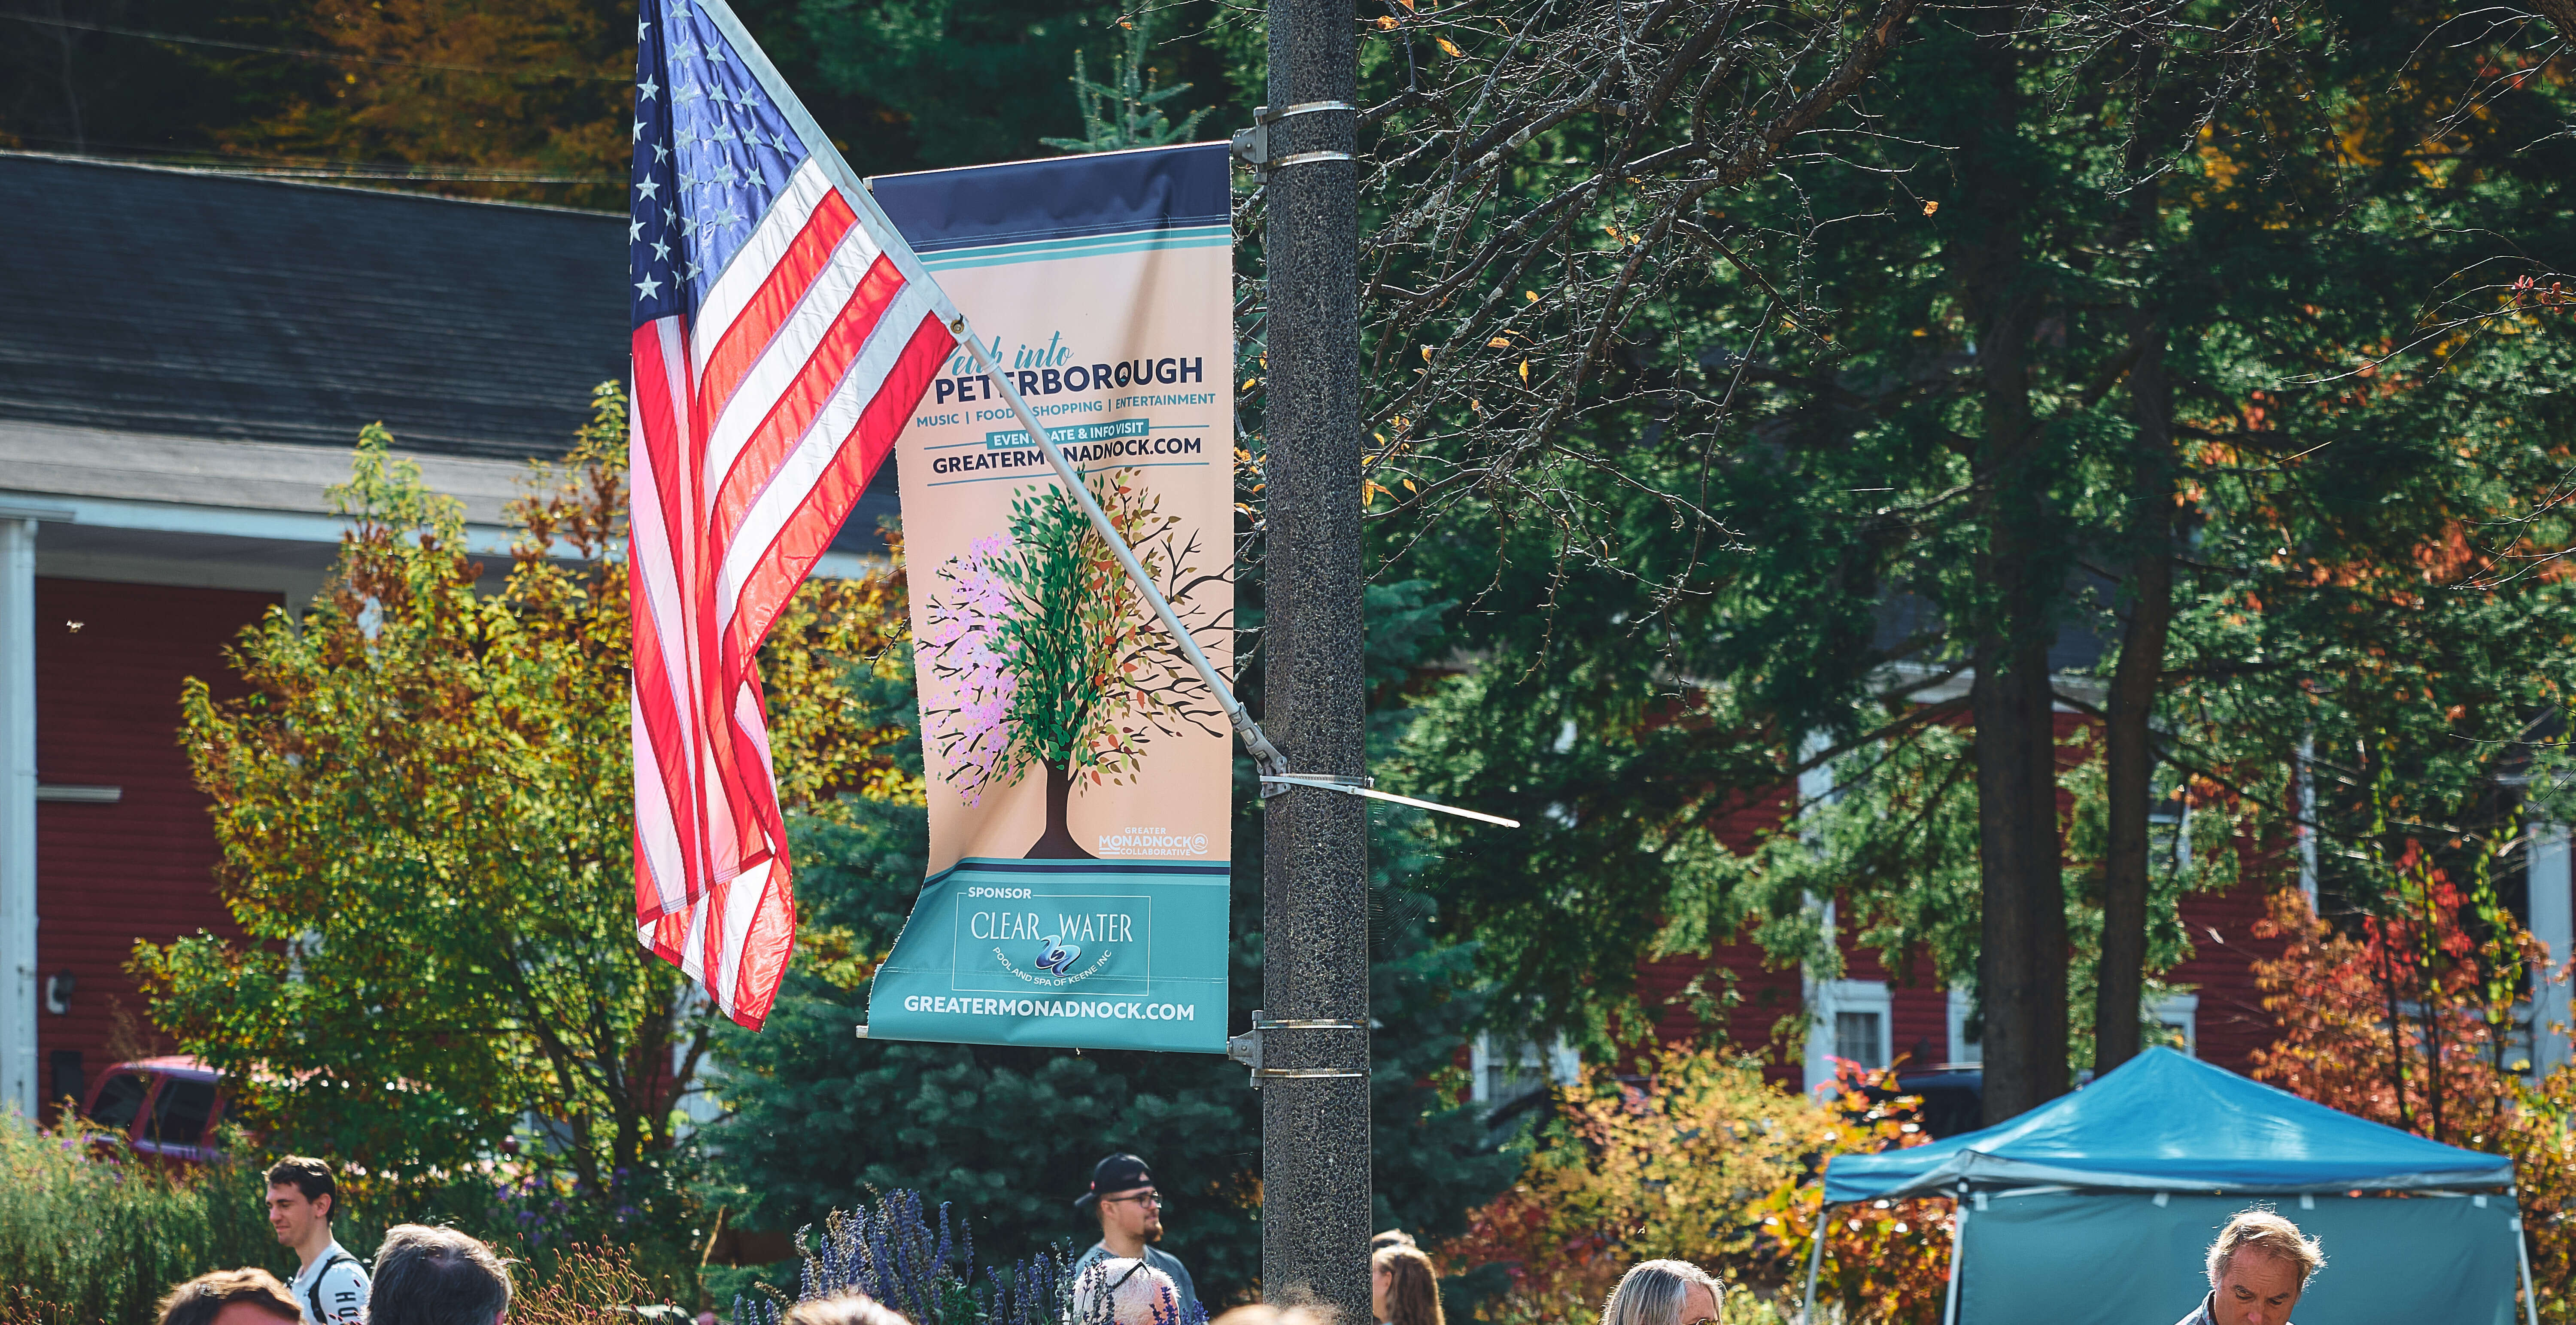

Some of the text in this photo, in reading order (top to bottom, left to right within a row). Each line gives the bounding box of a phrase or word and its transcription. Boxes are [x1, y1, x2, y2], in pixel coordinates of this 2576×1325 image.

[1014, 330, 1075, 370] into
[917, 413, 960, 428] MUSIC
[976, 408, 1015, 422] FOOD
[1032, 400, 1103, 417] SHOPPING
[1115, 393, 1216, 410] ENTERTAINMENT
[1046, 429, 1075, 441] ATE
[1078, 428, 1088, 439] &
[1090, 423, 1115, 439] INFO
[1116, 422, 1144, 435] VISIT
[933, 437, 1201, 474] GREATERMNADNOCK.COM
[1099, 835, 1192, 849] MONADNOCK
[968, 887, 1032, 899] SPONSOR
[971, 912, 1133, 942] CLEAR WATER
[992, 946, 1011, 971] POOL
[1011, 968, 1033, 982] AND
[1033, 977, 1052, 986] SPA
[1068, 964, 1098, 985] KEENE
[1096, 949, 1112, 967] INC
[904, 995, 1195, 1021] GREATERMONADNOCK.COM
